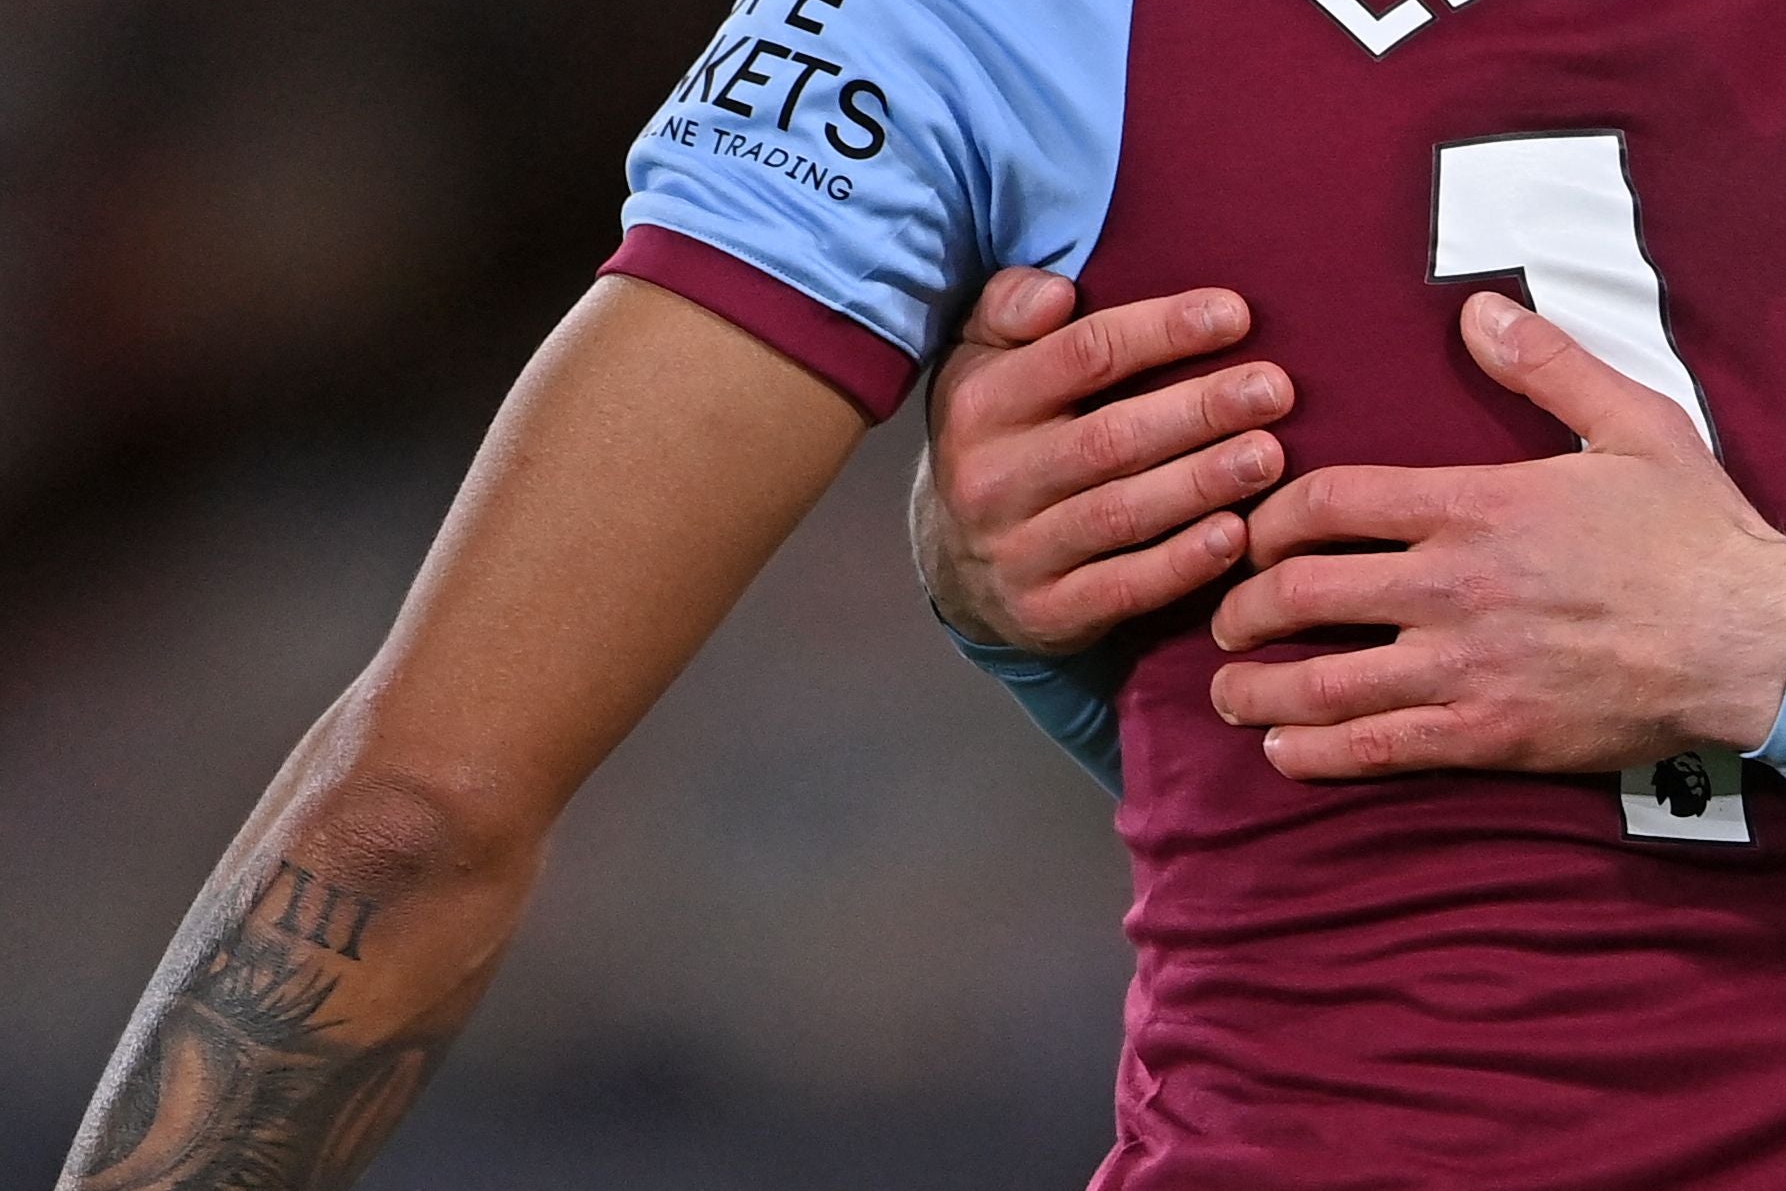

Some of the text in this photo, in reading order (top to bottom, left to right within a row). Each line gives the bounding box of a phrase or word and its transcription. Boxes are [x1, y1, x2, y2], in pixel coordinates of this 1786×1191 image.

[677, 33, 888, 160] KETS
[645, 115, 853, 201] NE TRADING
